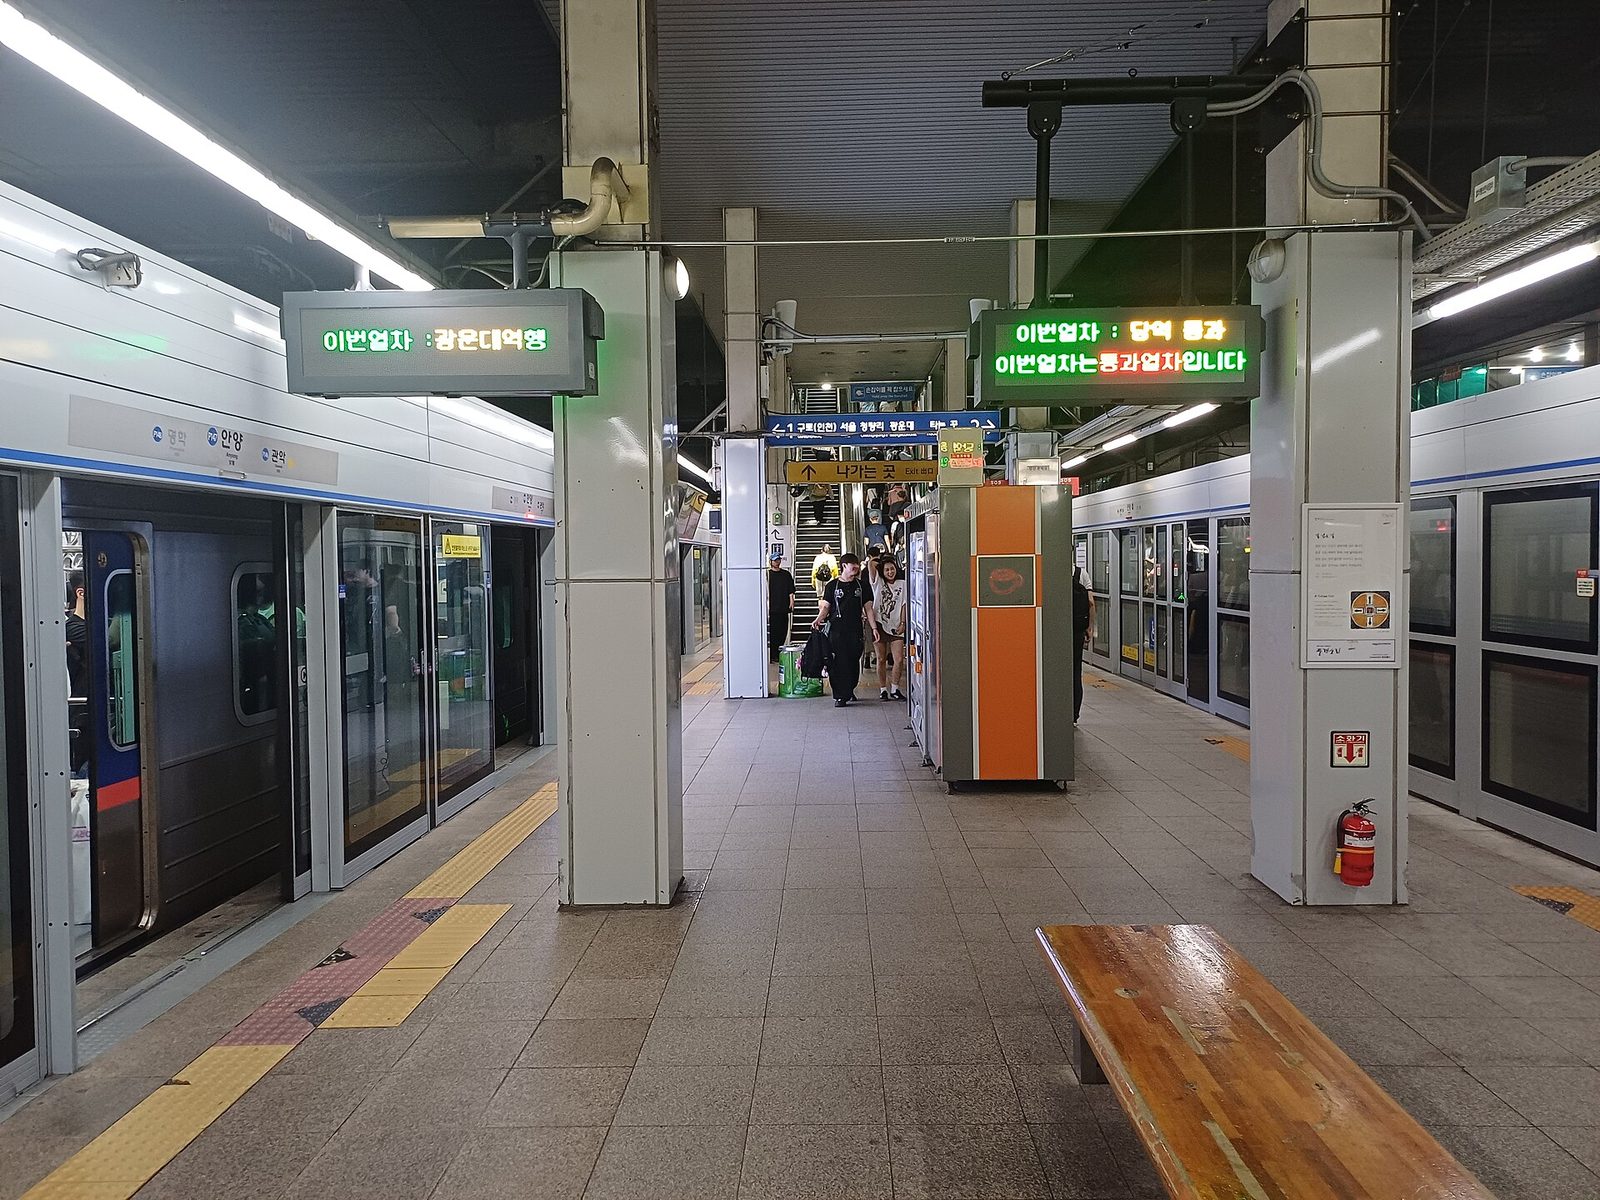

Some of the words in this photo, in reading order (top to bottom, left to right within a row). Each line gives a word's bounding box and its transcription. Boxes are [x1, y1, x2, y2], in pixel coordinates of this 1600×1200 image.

[323, 329, 413, 352] 이번열차
[1016, 322, 1100, 344] 이번열차
[1129, 320, 1172, 342] 당역
[1182, 319, 1227, 341] 통과
[840, 421, 857, 432] 서울
[221, 429, 244, 452] 안양
[836, 464, 877, 479] 나가는
[883, 464, 896, 479] 곳
[905, 467, 919, 475] Exit
[1336, 735, 1365, 743] 소화기
